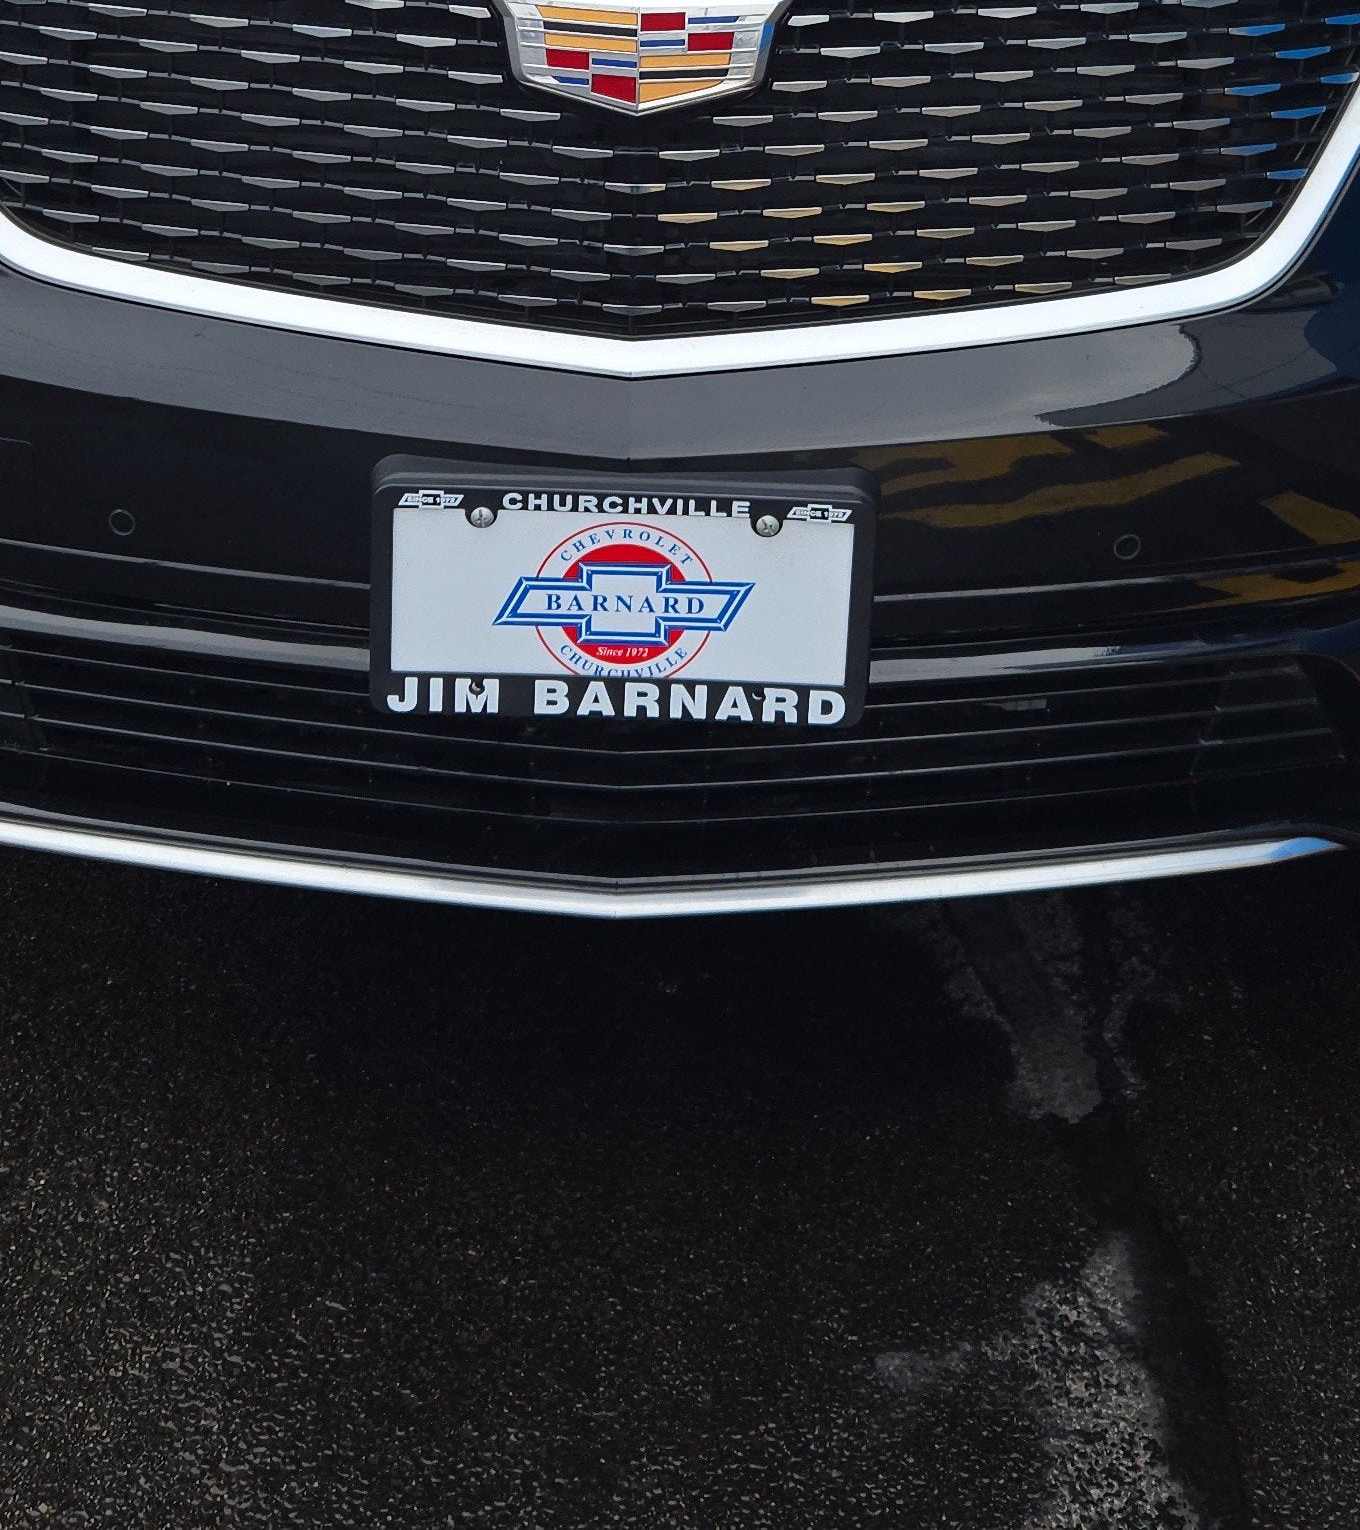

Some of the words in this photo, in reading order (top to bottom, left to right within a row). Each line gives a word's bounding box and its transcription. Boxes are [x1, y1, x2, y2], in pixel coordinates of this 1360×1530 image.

[502, 492, 751, 518] CHURCHVILLE
[560, 528, 694, 566] CHEVROLET
[545, 593, 705, 615] BARNARD
[560, 644, 688, 678] CHURCHVILLE
[596, 646, 624, 657] Since
[625, 647, 649, 658] 1972
[386, 676, 500, 714] JIM
[533, 679, 847, 726] BARNARD
